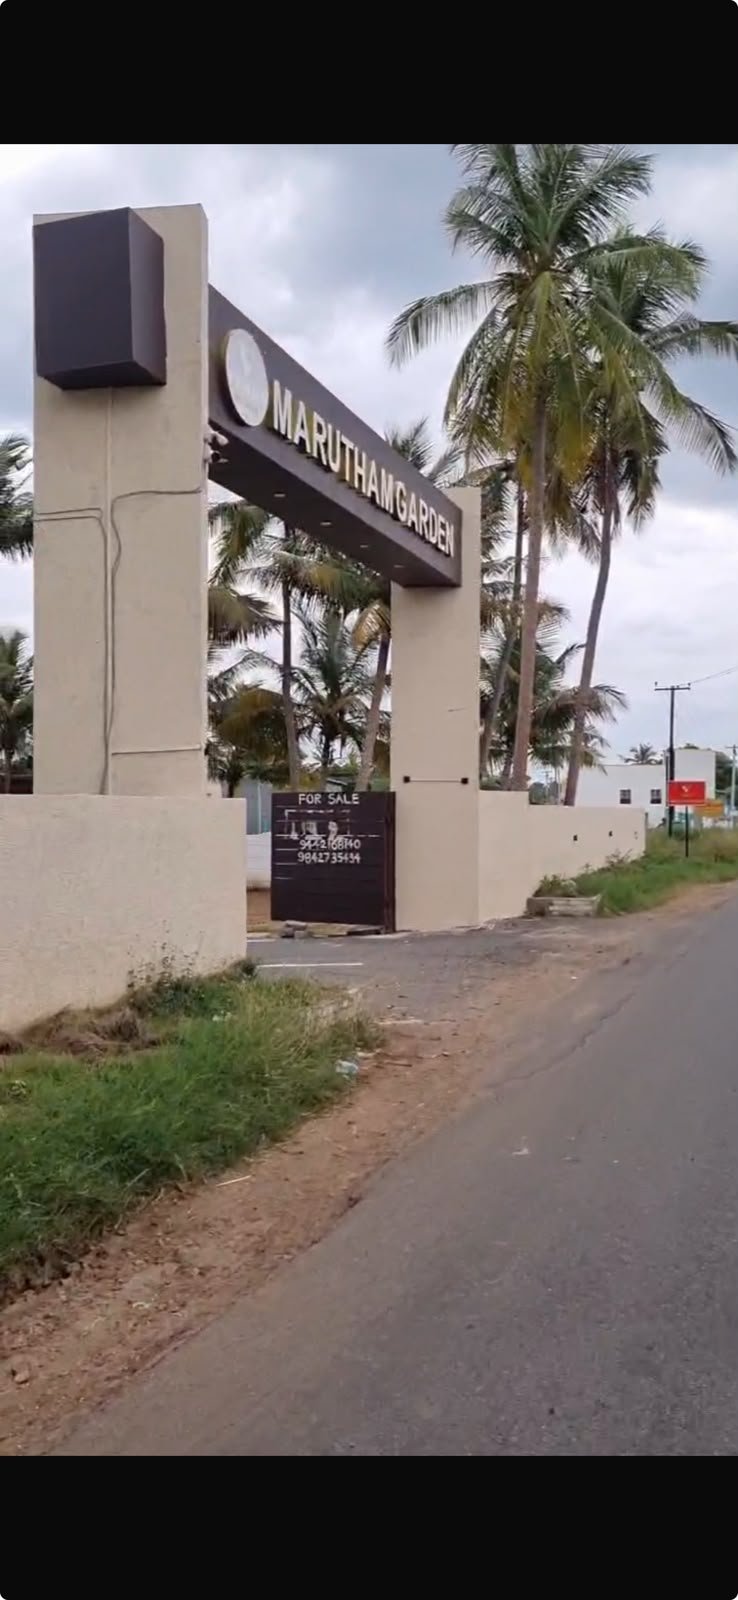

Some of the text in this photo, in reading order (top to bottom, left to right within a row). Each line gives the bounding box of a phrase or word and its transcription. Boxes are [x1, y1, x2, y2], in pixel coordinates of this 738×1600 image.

[273, 380, 454, 557] MARUTHAM GARDEN
[298, 793, 360, 805] FOR SALE
